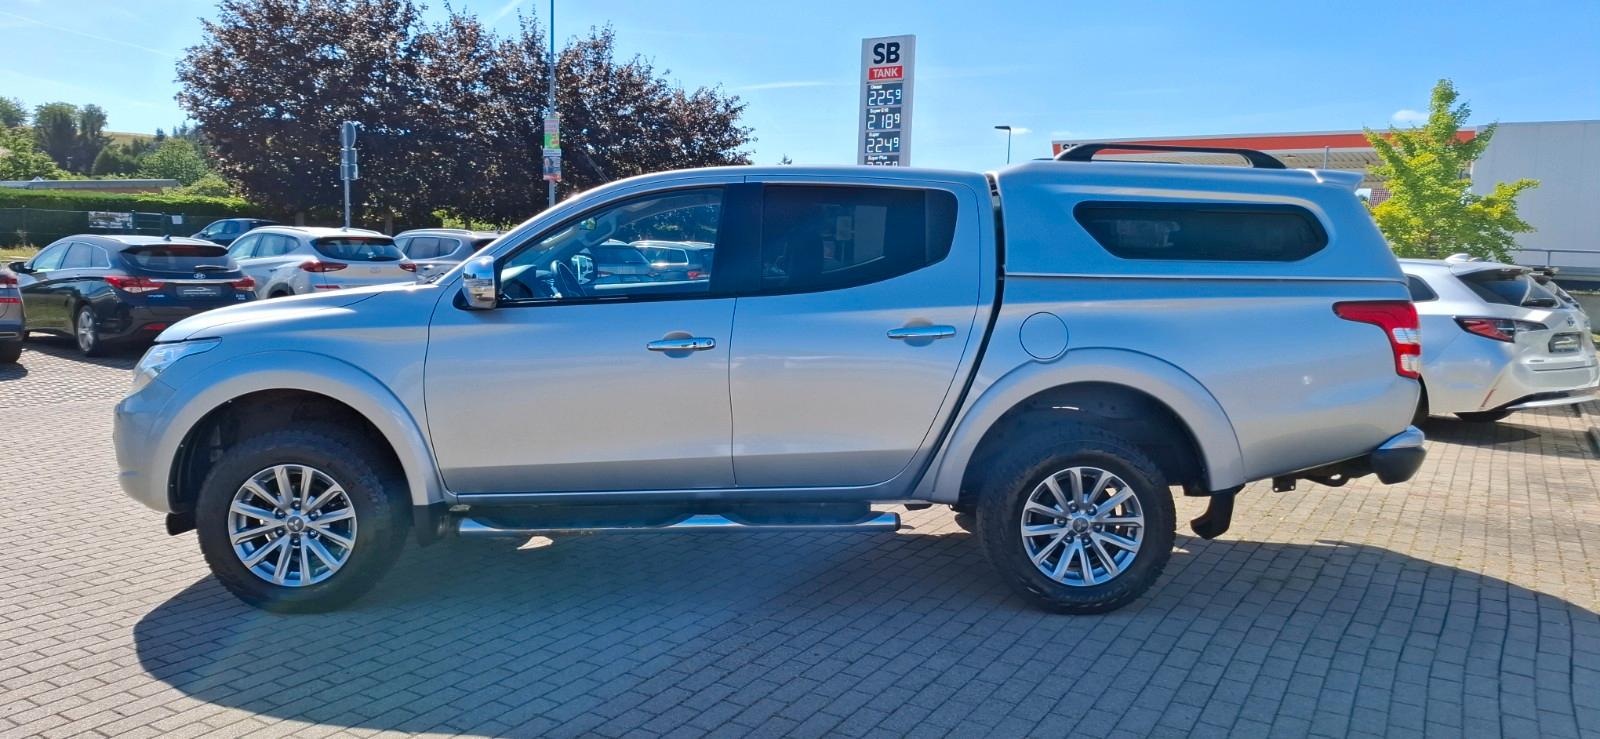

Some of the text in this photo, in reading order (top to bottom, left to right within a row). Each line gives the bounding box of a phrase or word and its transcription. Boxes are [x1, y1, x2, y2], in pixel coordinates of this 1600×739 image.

[873, 42, 900, 64] SB
[872, 67, 898, 78] TANK
[869, 89, 901, 105] 2259
[867, 137, 899, 152] 2249
